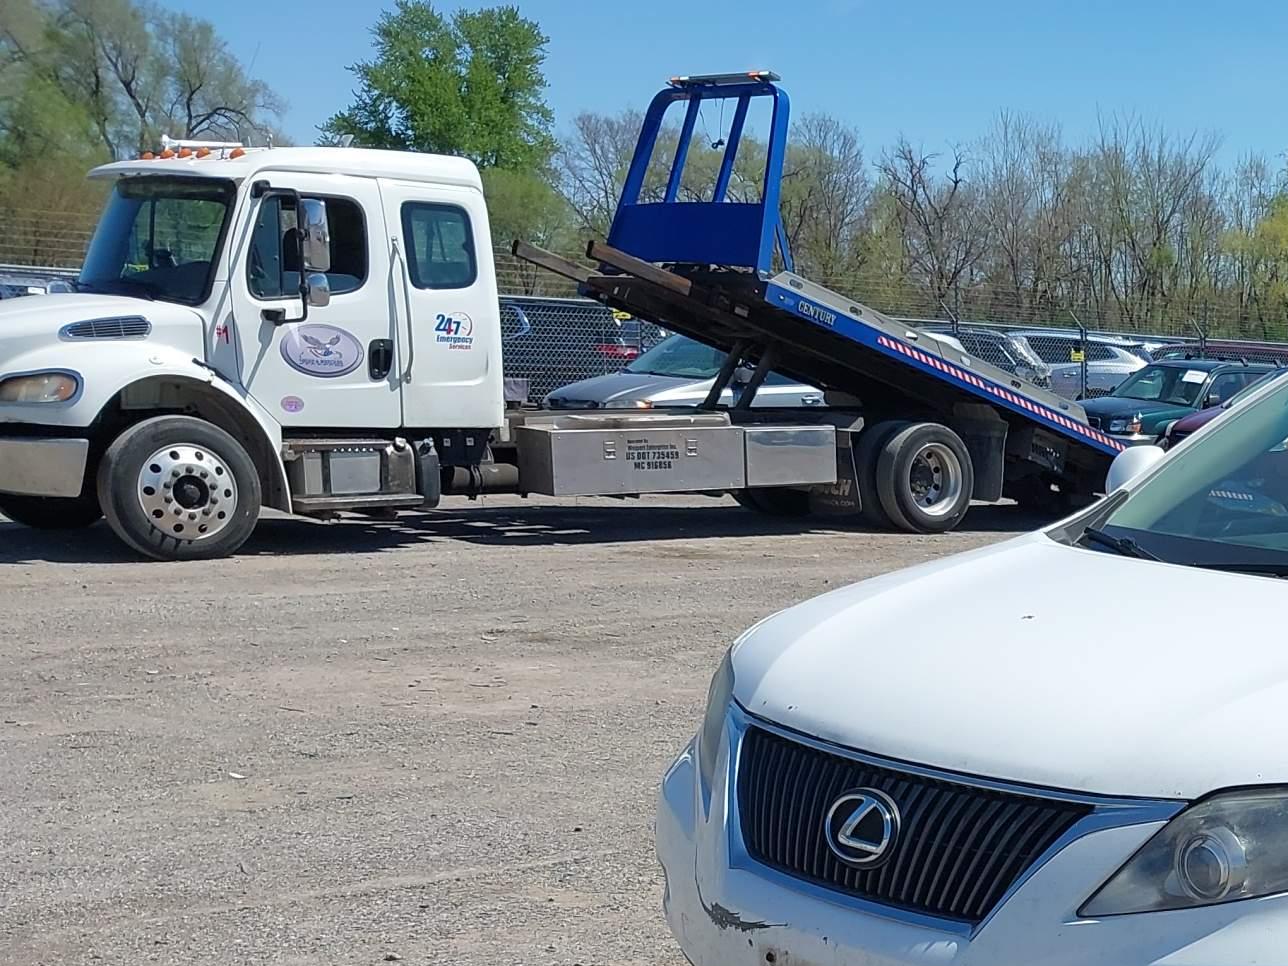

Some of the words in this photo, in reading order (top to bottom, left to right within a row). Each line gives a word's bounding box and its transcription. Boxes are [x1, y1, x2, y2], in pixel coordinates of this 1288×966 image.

[798, 300, 837, 327] CENTURY
[216, 325, 229, 345] #1
[436, 335, 473, 344] Emergency
[625, 451, 636, 461] US
[636, 451, 650, 460] DOT
[633, 461, 645, 471] MC
